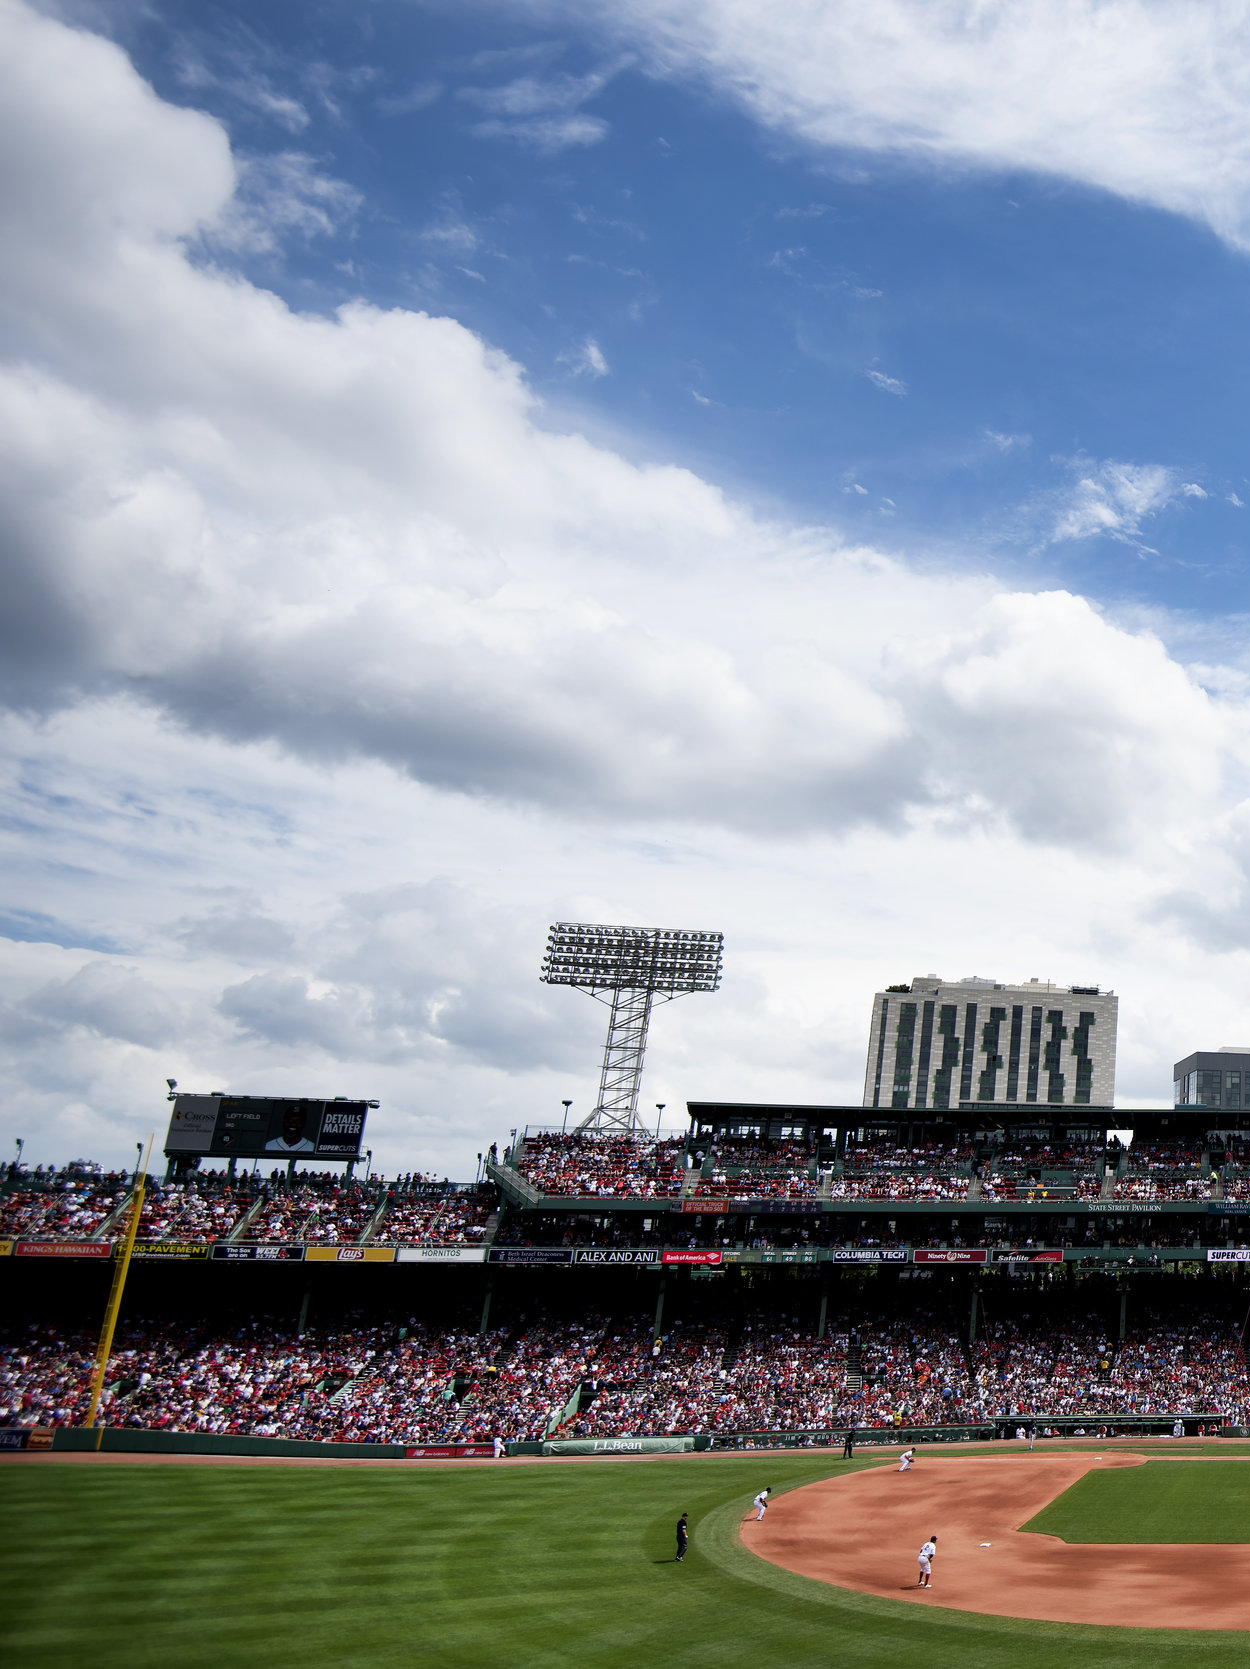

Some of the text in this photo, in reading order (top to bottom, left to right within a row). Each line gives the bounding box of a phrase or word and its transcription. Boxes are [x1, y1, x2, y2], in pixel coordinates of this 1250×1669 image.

[184, 1111, 215, 1121] CROSS
[325, 1113, 362, 1124] DETAILS
[322, 1123, 360, 1134] MATTER
[318, 1144, 356, 1152] SUPERCUTS
[1088, 1203, 1162, 1211] STATE STREET PAVILION
[117, 1245, 208, 1254] 1-00-PAVEMENT
[580, 1252, 654, 1262] ALEX AND ANI
[835, 1251, 905, 1259] COLUMBIA TECH
[593, 1441, 643, 1451] L.L.Bean
